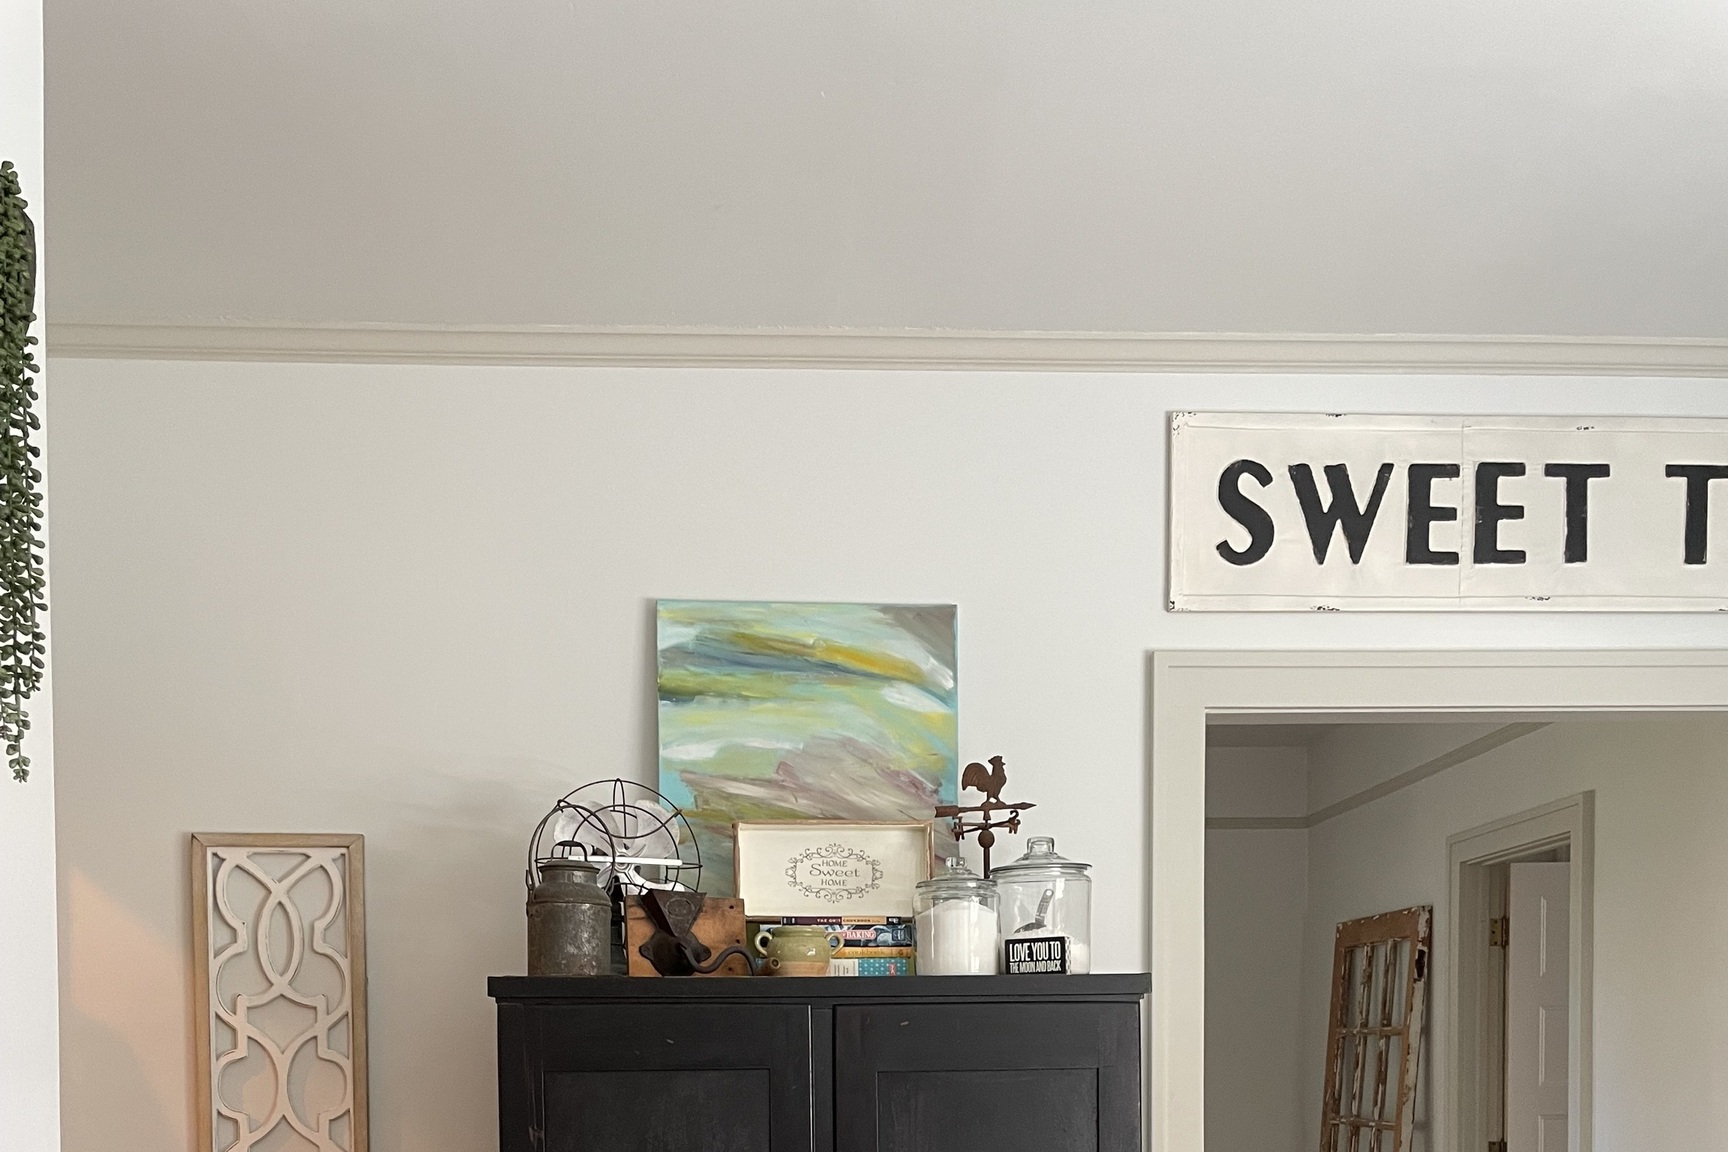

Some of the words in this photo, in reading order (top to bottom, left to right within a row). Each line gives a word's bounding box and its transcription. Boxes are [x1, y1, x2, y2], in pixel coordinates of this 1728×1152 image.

[1216, 459, 1610, 566] SWEET
[809, 863, 861, 878] Sweet
[822, 860, 848, 868] HOME
[820, 879, 848, 887] HOME
[846, 930, 875, 939] BAKING
[1009, 943, 1031, 962] LOVE
[1031, 941, 1049, 960] YOU
[1049, 941, 1061, 960] TO
[1009, 962, 1020, 974] THE
[1020, 961, 1036, 973] MOON
[1036, 960, 1047, 972] AND
[1047, 960, 1061, 972] BACK
